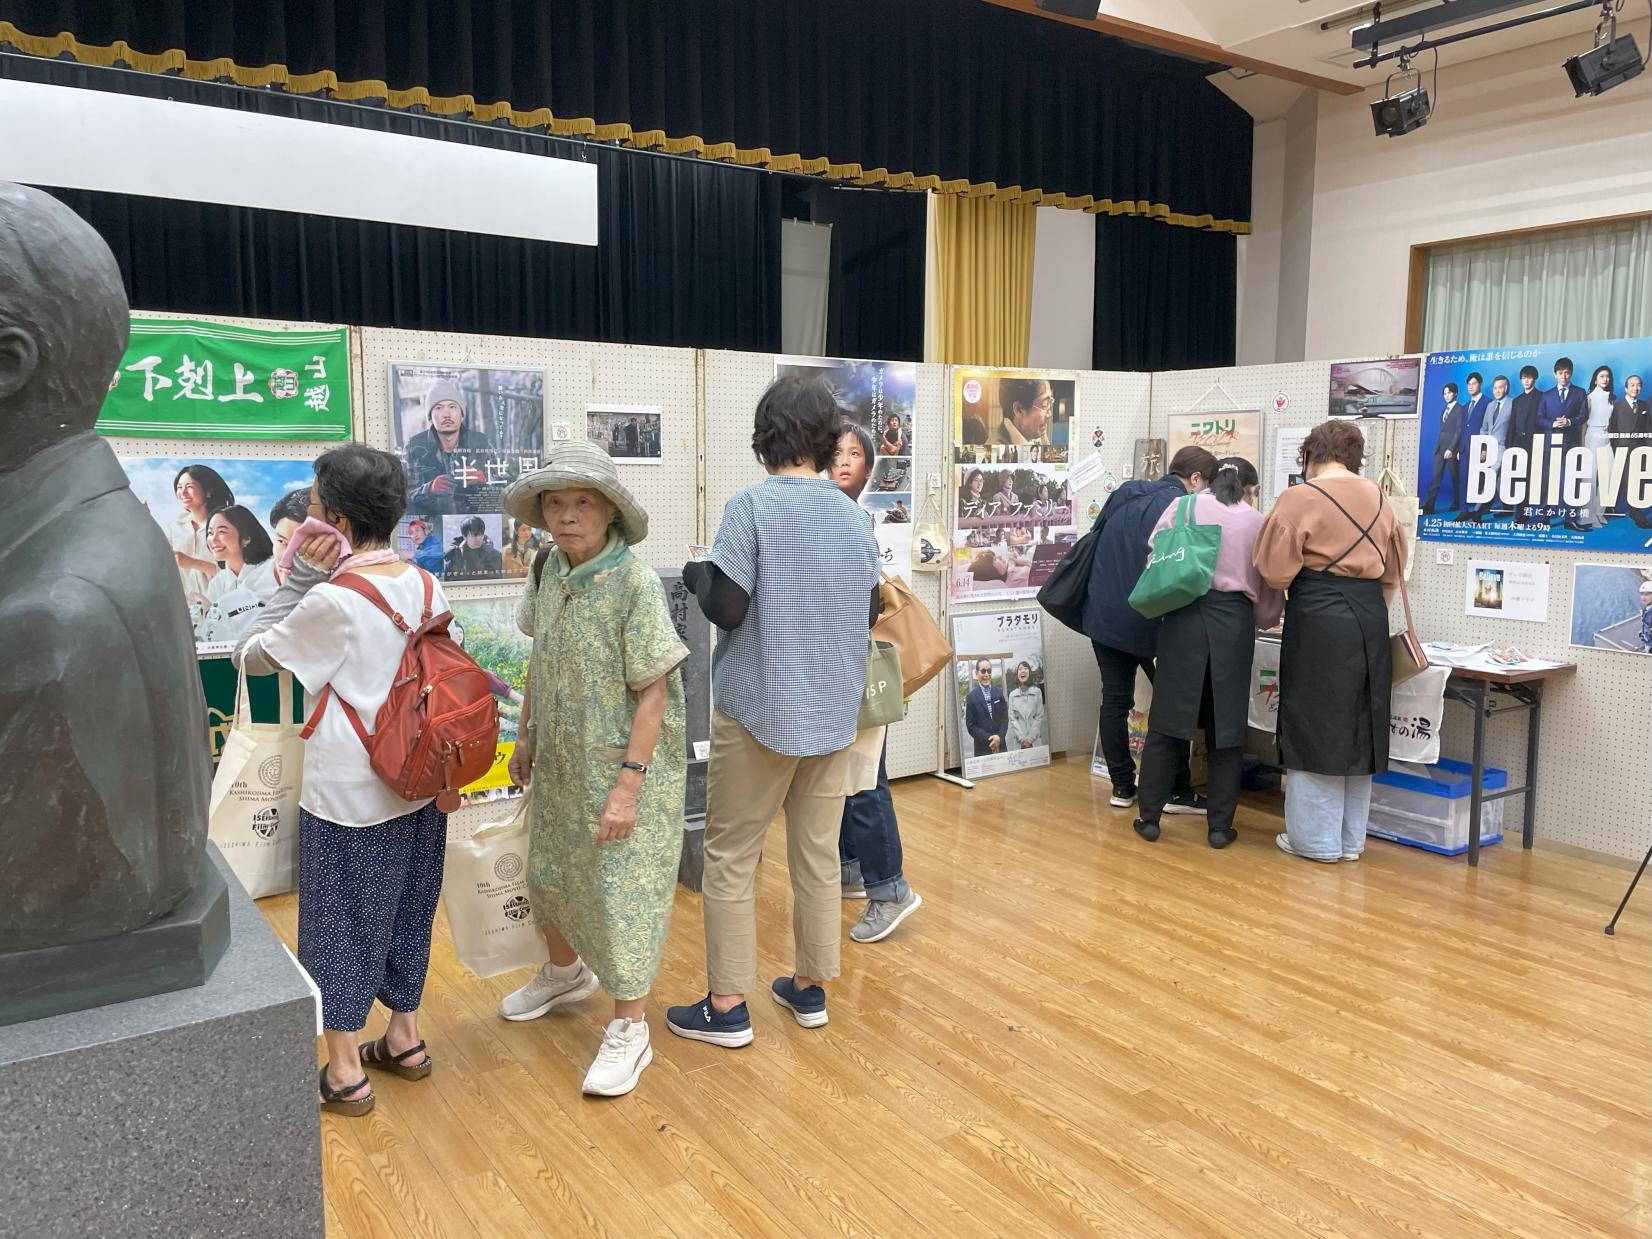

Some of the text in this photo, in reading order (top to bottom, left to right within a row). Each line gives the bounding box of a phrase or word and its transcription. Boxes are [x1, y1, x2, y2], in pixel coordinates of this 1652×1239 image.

[125, 354, 264, 403] 下剋上
[1467, 433, 1652, 509] Believe
[963, 499, 1067, 519] ディア・ファミリー
[1523, 507, 1590, 518] 君にかける橋
[1423, 518, 1442, 528] 4.25
